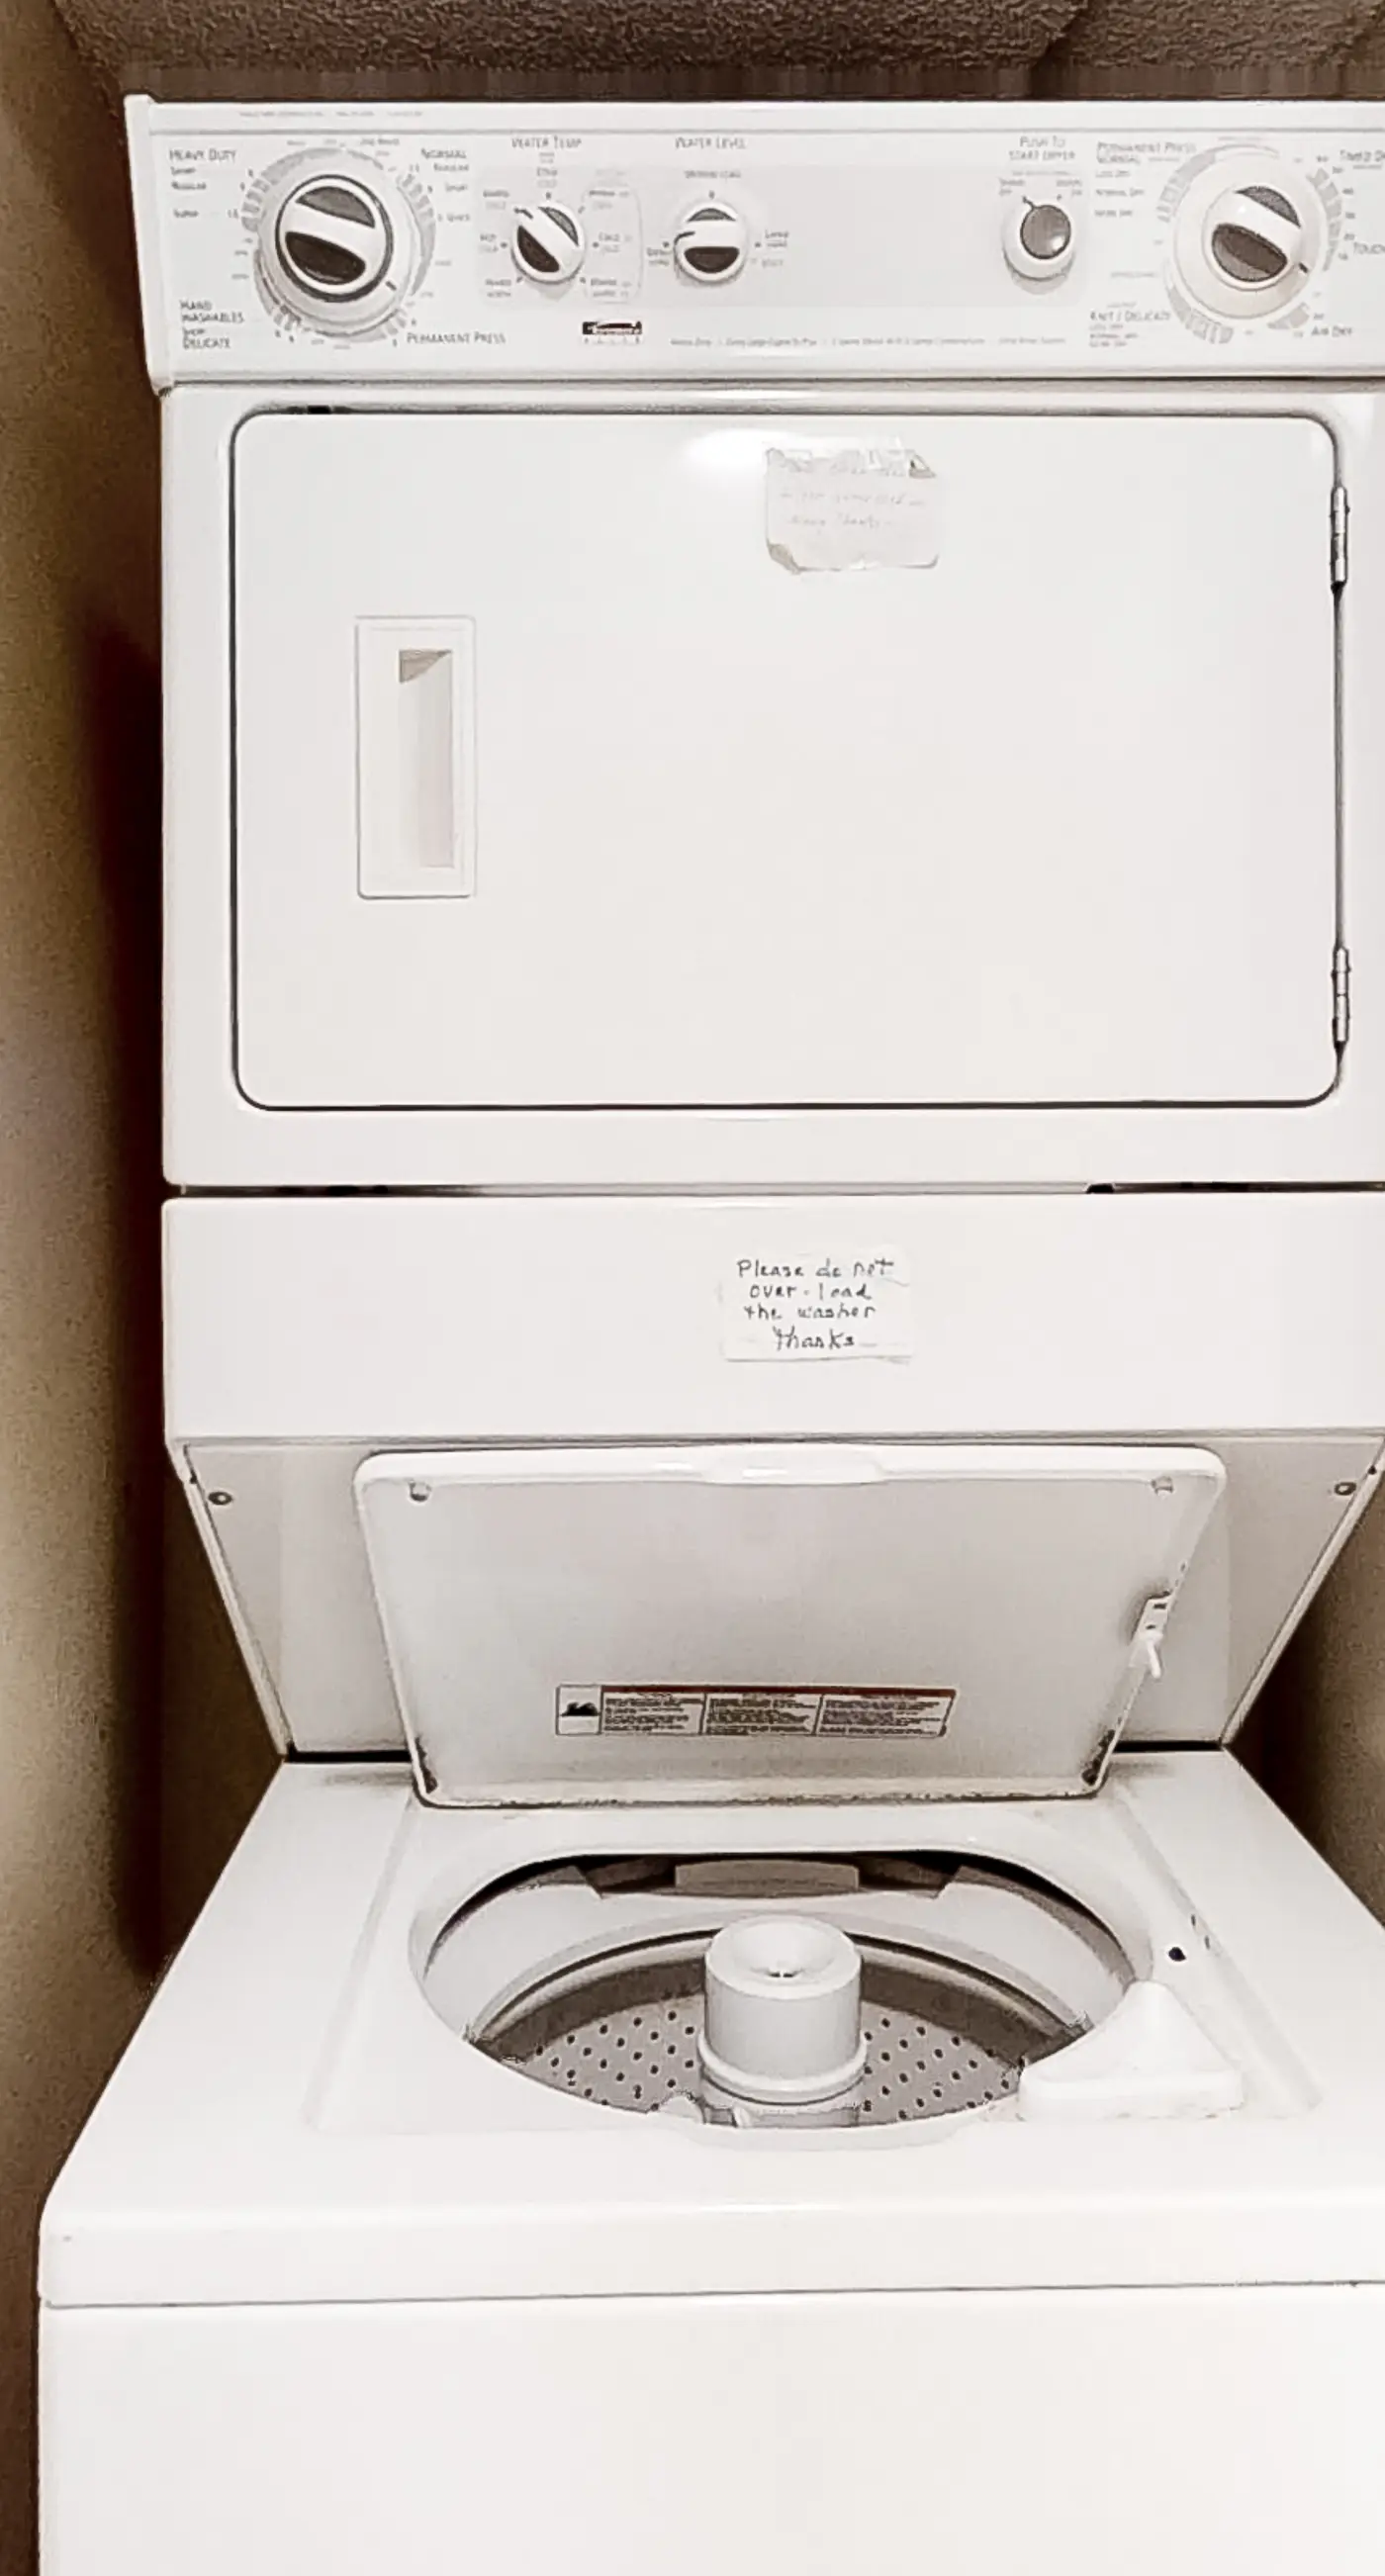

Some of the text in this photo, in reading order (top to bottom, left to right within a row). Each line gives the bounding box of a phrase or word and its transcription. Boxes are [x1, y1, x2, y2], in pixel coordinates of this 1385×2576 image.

[169, 147, 237, 161] HEAVY DUTY
[407, 330, 508, 344] PERMANENT PRESS
[736, 1258, 805, 1279] Please
[853, 1257, 895, 1277] not
[744, 1302, 876, 1321] the washer
